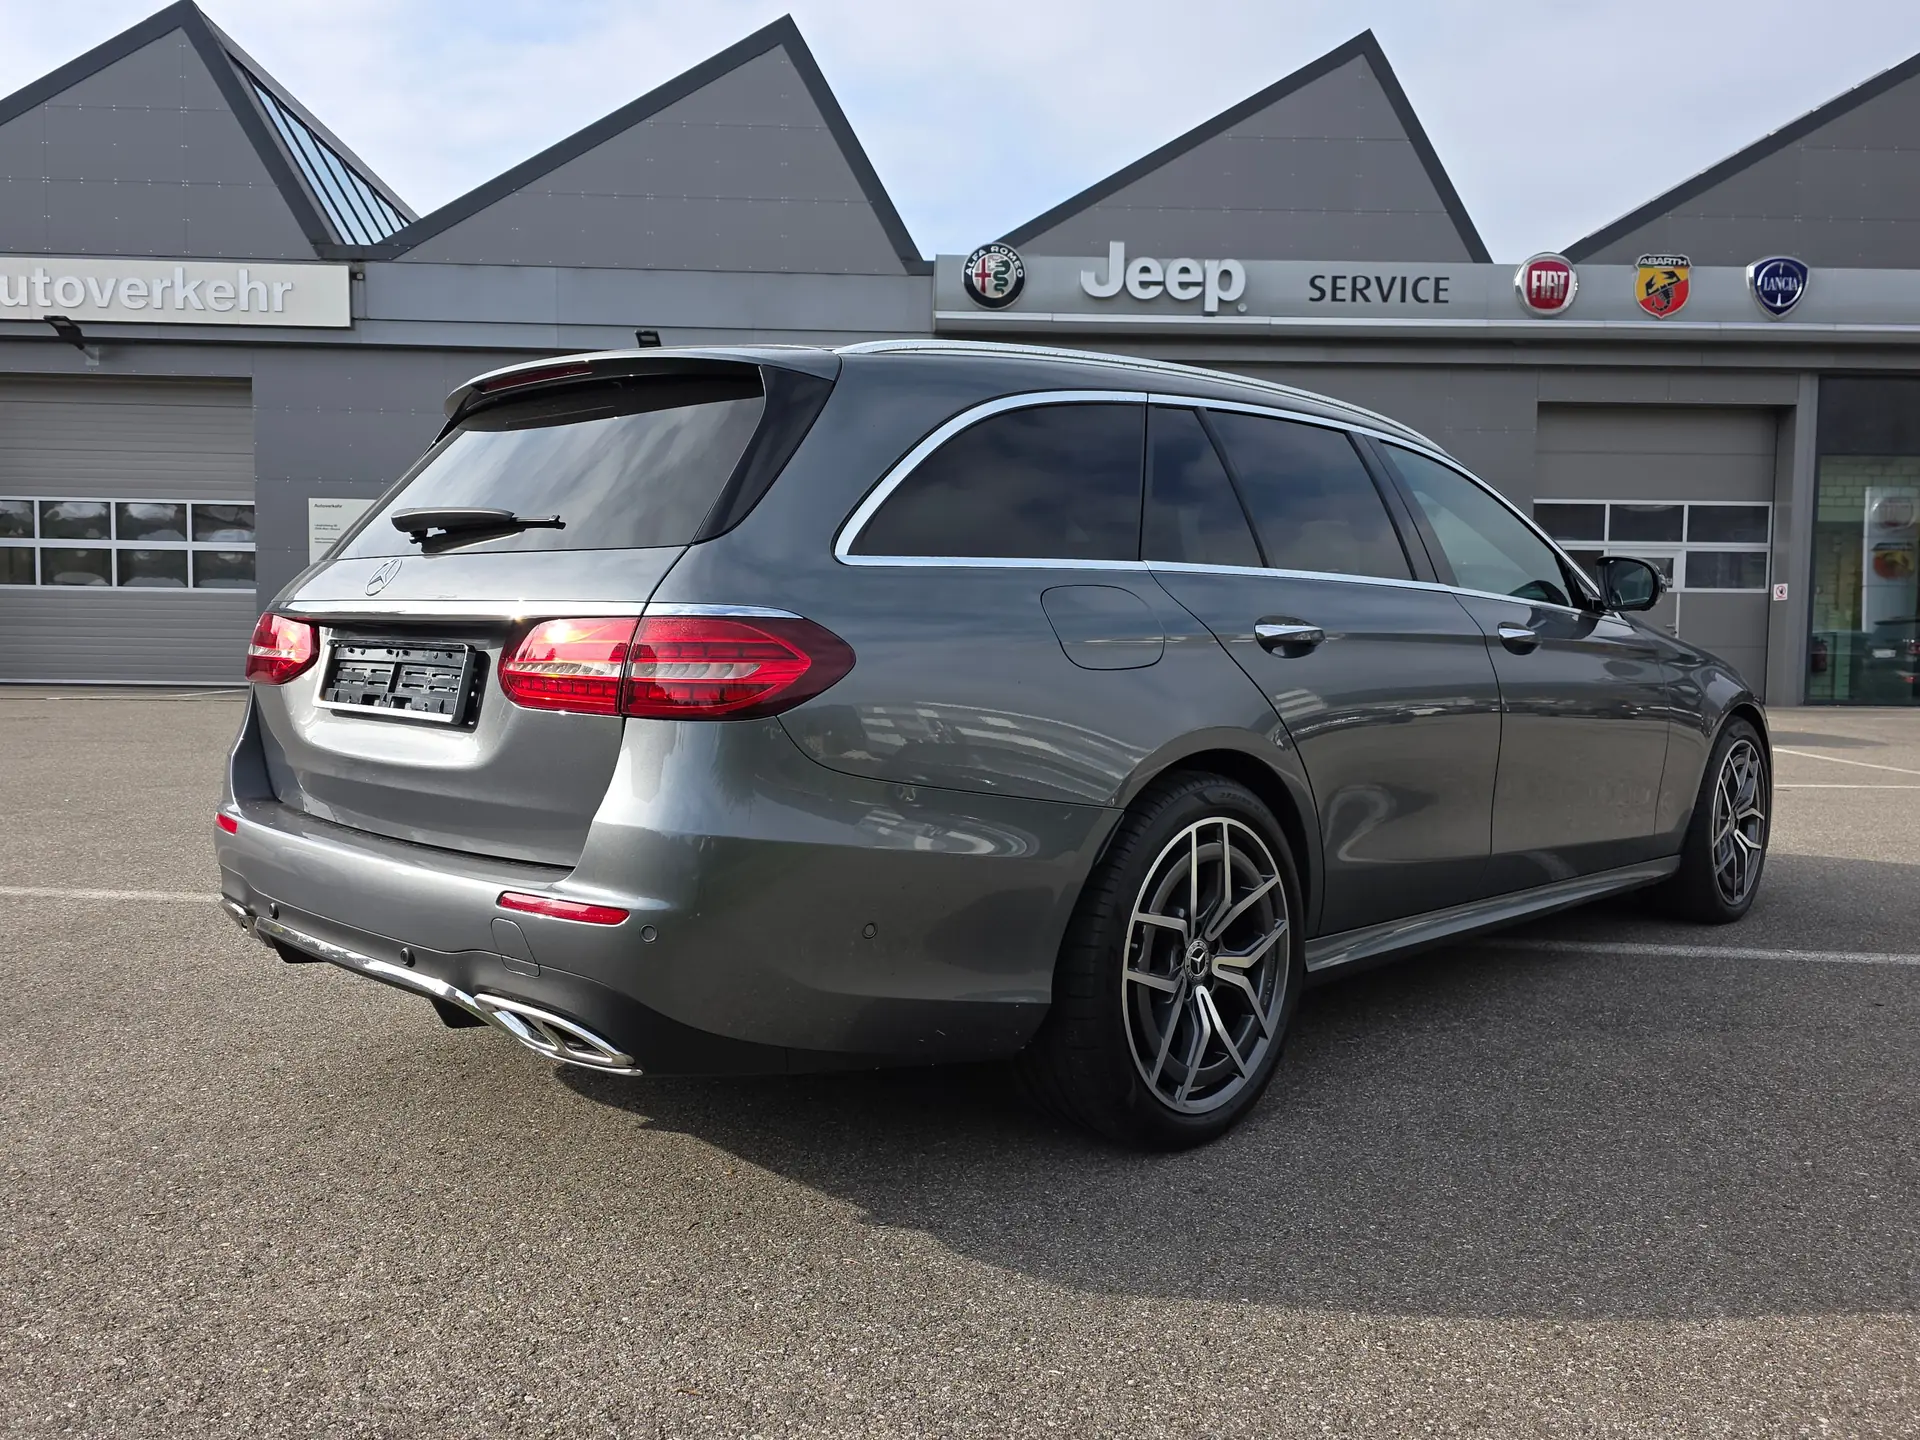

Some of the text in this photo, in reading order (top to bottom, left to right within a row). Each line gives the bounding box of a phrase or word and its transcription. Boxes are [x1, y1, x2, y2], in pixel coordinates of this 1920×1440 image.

[965, 245, 1024, 278] ALFA ROMEO
[1640, 255, 1688, 266] ABARTH
[0, 266, 293, 312] utoverkehr
[1080, 240, 1247, 313] Jeep
[1308, 274, 1451, 304] SERVICE
[1531, 270, 1568, 299] FIAT
[1763, 276, 1798, 291] LANCIA
